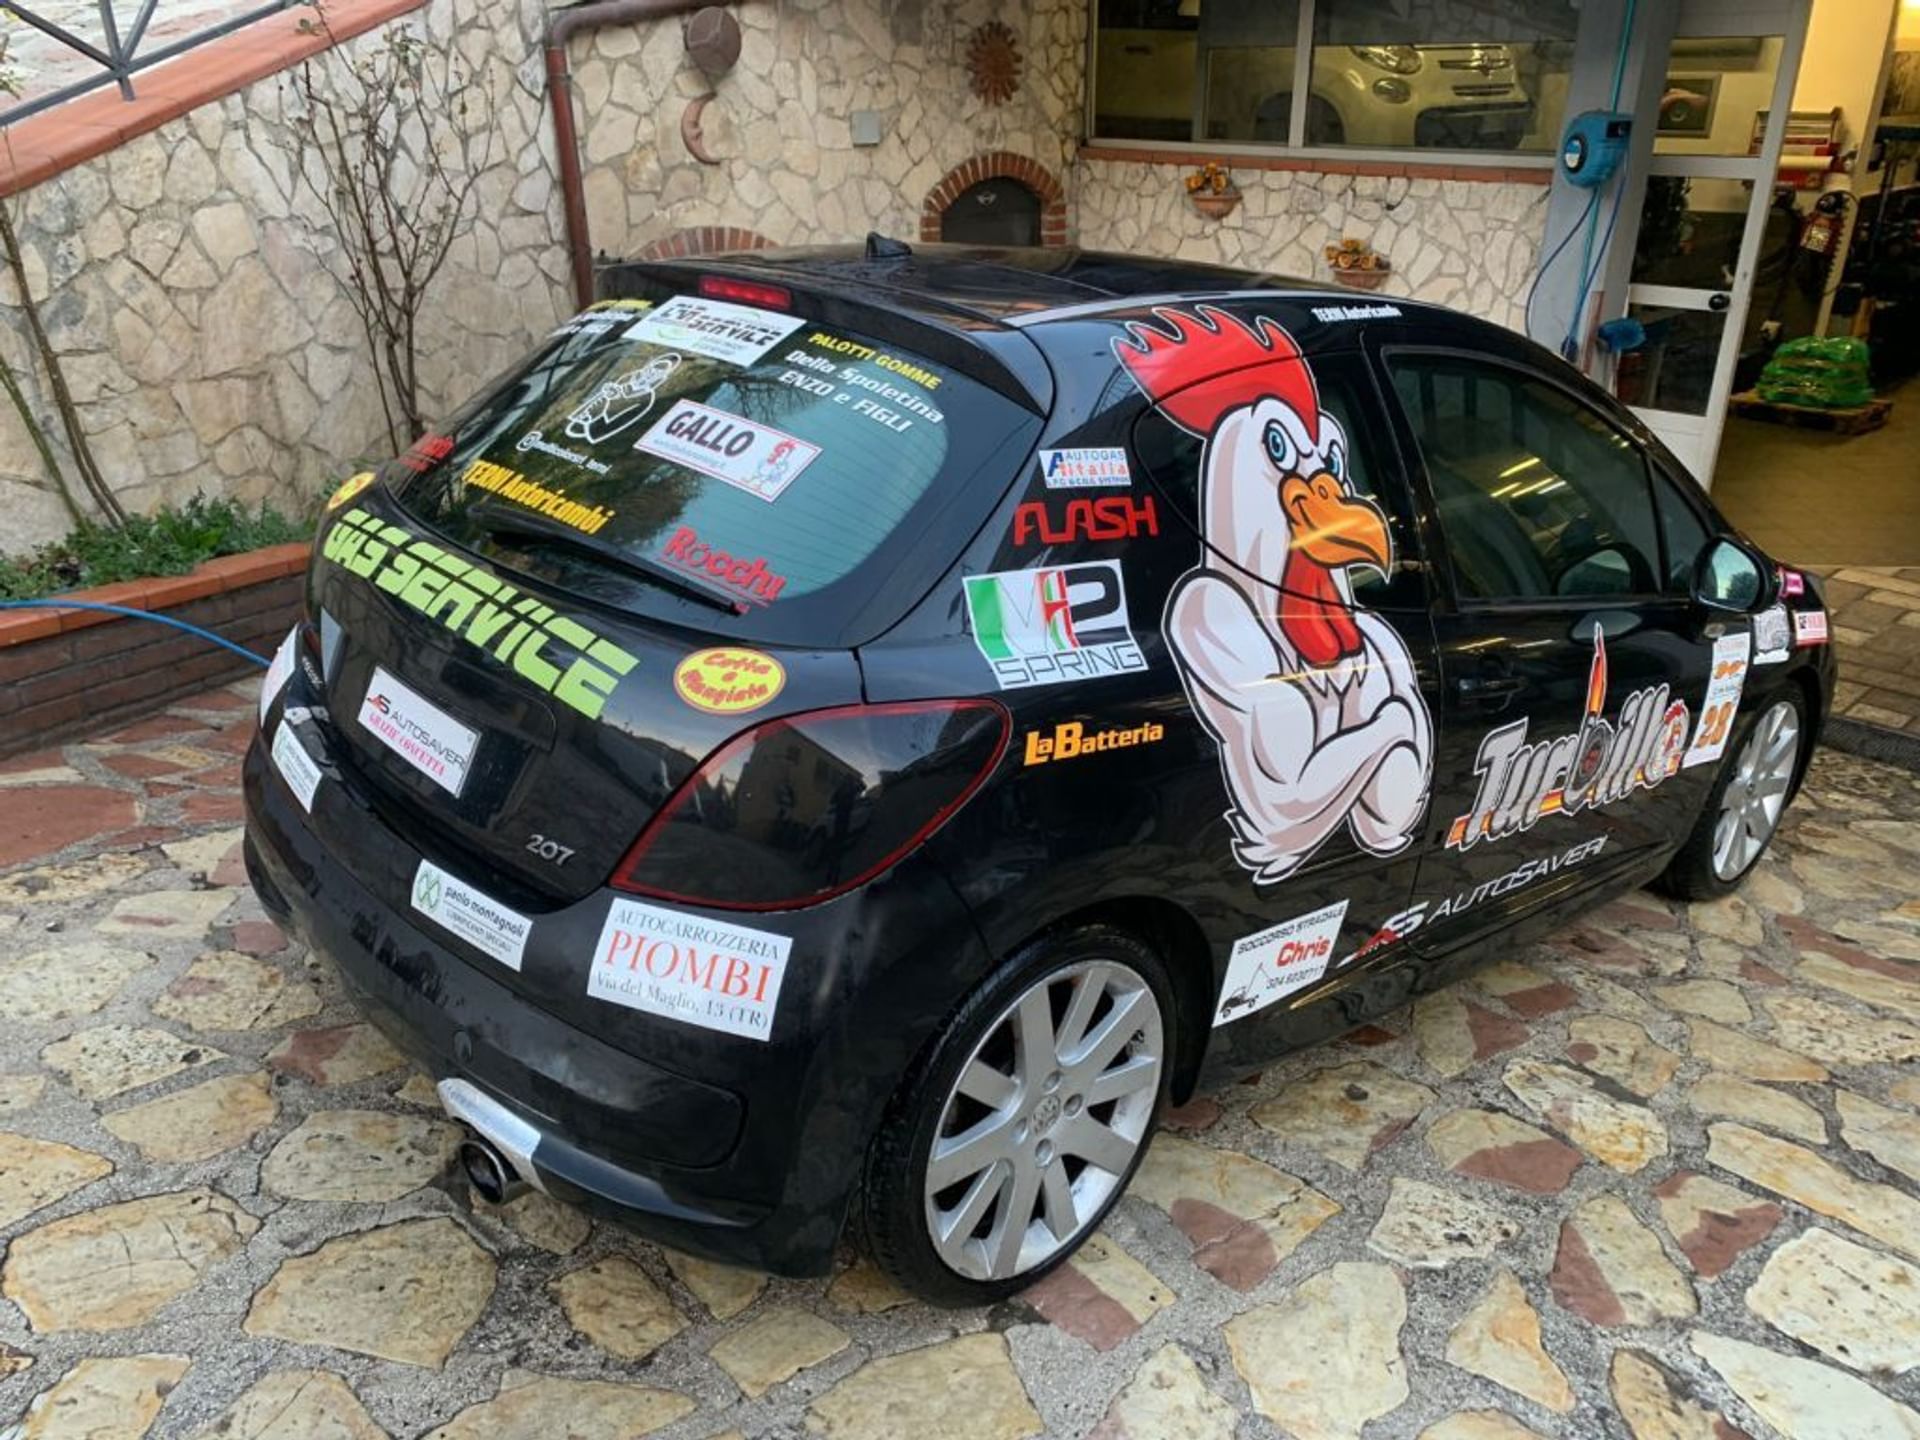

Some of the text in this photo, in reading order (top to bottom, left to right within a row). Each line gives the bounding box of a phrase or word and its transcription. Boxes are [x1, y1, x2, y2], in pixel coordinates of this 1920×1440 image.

[785, 350, 944, 424] Della Spoletina
[808, 333, 943, 390] PALOTTI GOMME
[778, 370, 914, 433] ENZO e FIGLI
[665, 410, 755, 457] GALLO
[1014, 495, 1159, 546] FLASH
[375, 541, 640, 721] SERVICE
[993, 643, 1144, 686] SPRING
[391, 711, 467, 771] AUTOSAVER
[526, 834, 575, 866] 207
[445, 886, 470, 907] paolo
[614, 908, 779, 960] AUTOCARROZZERIA
[1275, 935, 1331, 968] Chris
[604, 929, 773, 1004] PIOMBI
[597, 971, 618, 993] Via
[620, 975, 642, 997] del
[728, 1004, 769, 1031] (TR)
